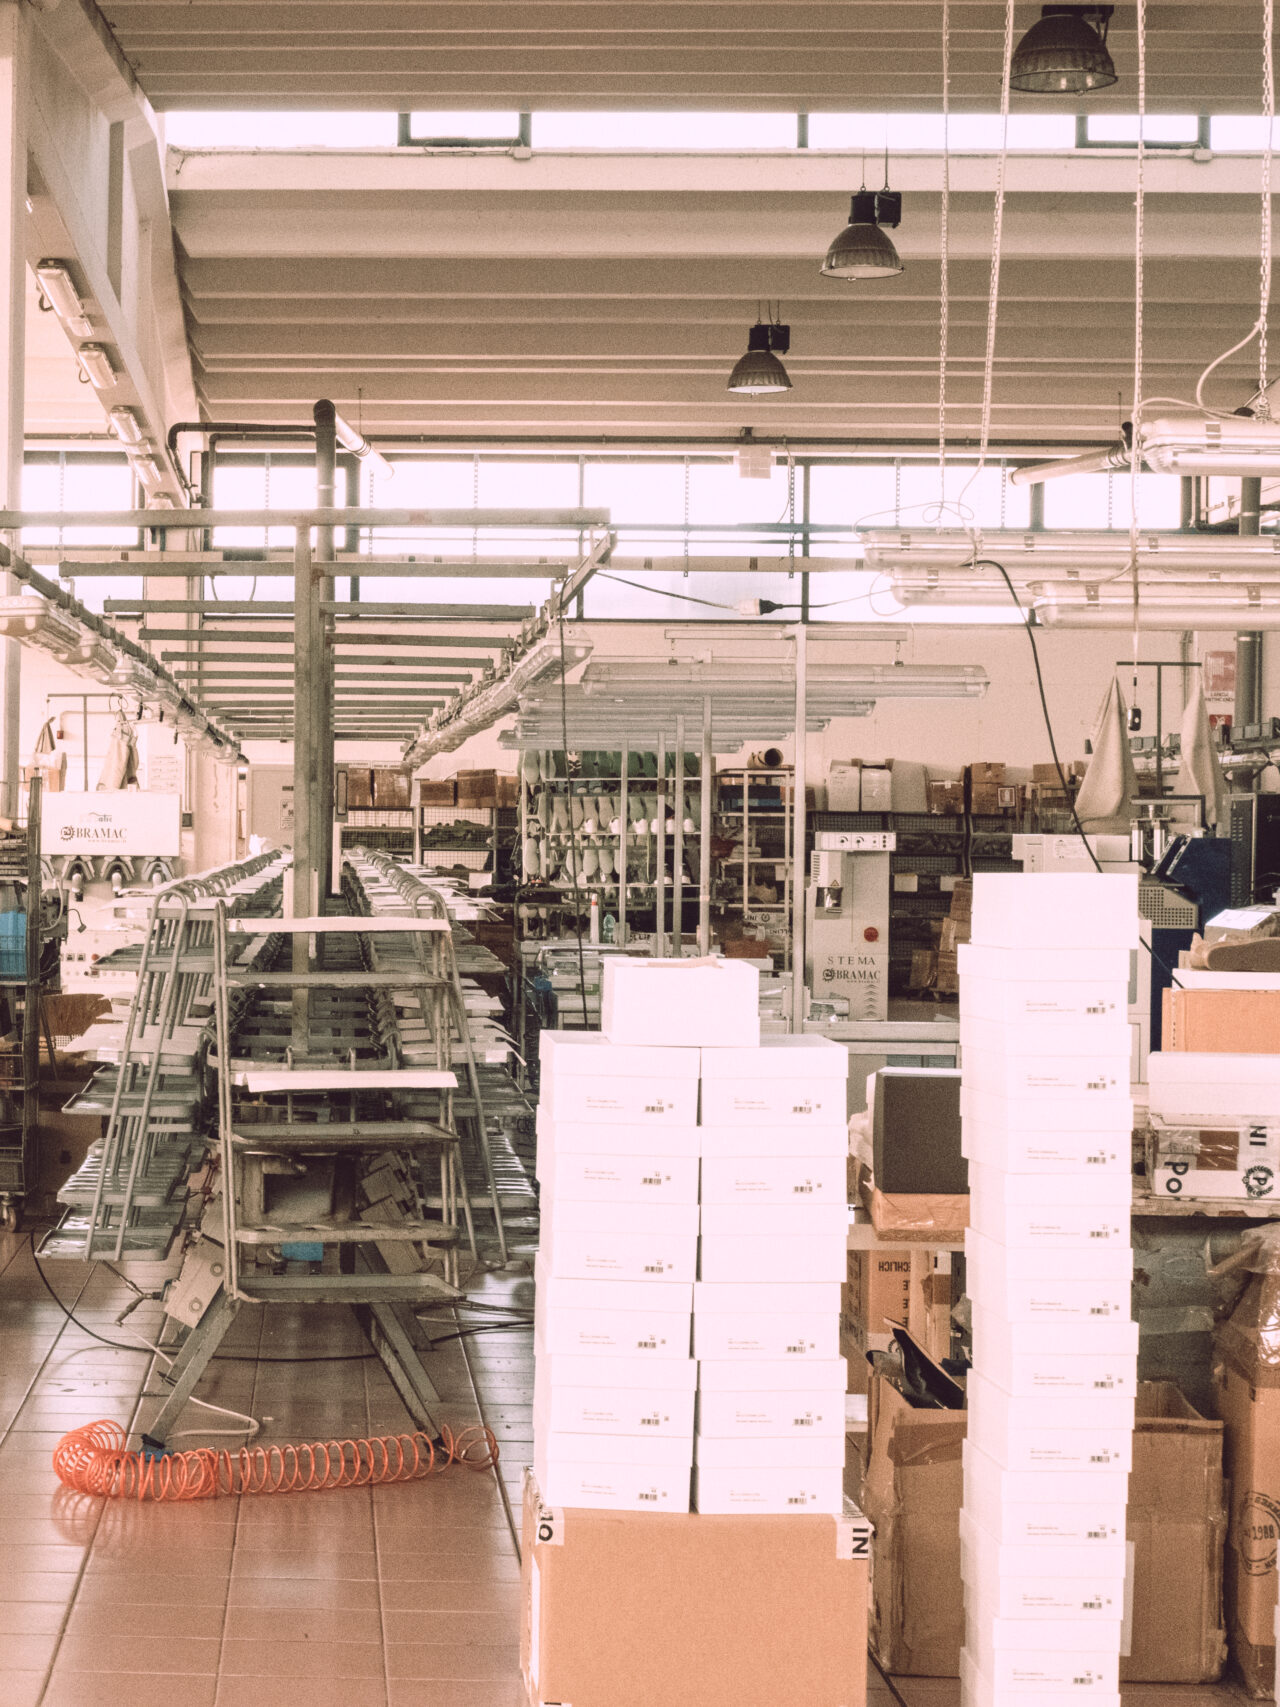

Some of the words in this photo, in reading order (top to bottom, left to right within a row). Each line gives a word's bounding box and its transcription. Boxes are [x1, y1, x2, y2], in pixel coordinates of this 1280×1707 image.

[75, 827, 128, 839] BRAMAC
[827, 955, 876, 966] STEMA
[836, 969, 881, 980] BRAMAC
